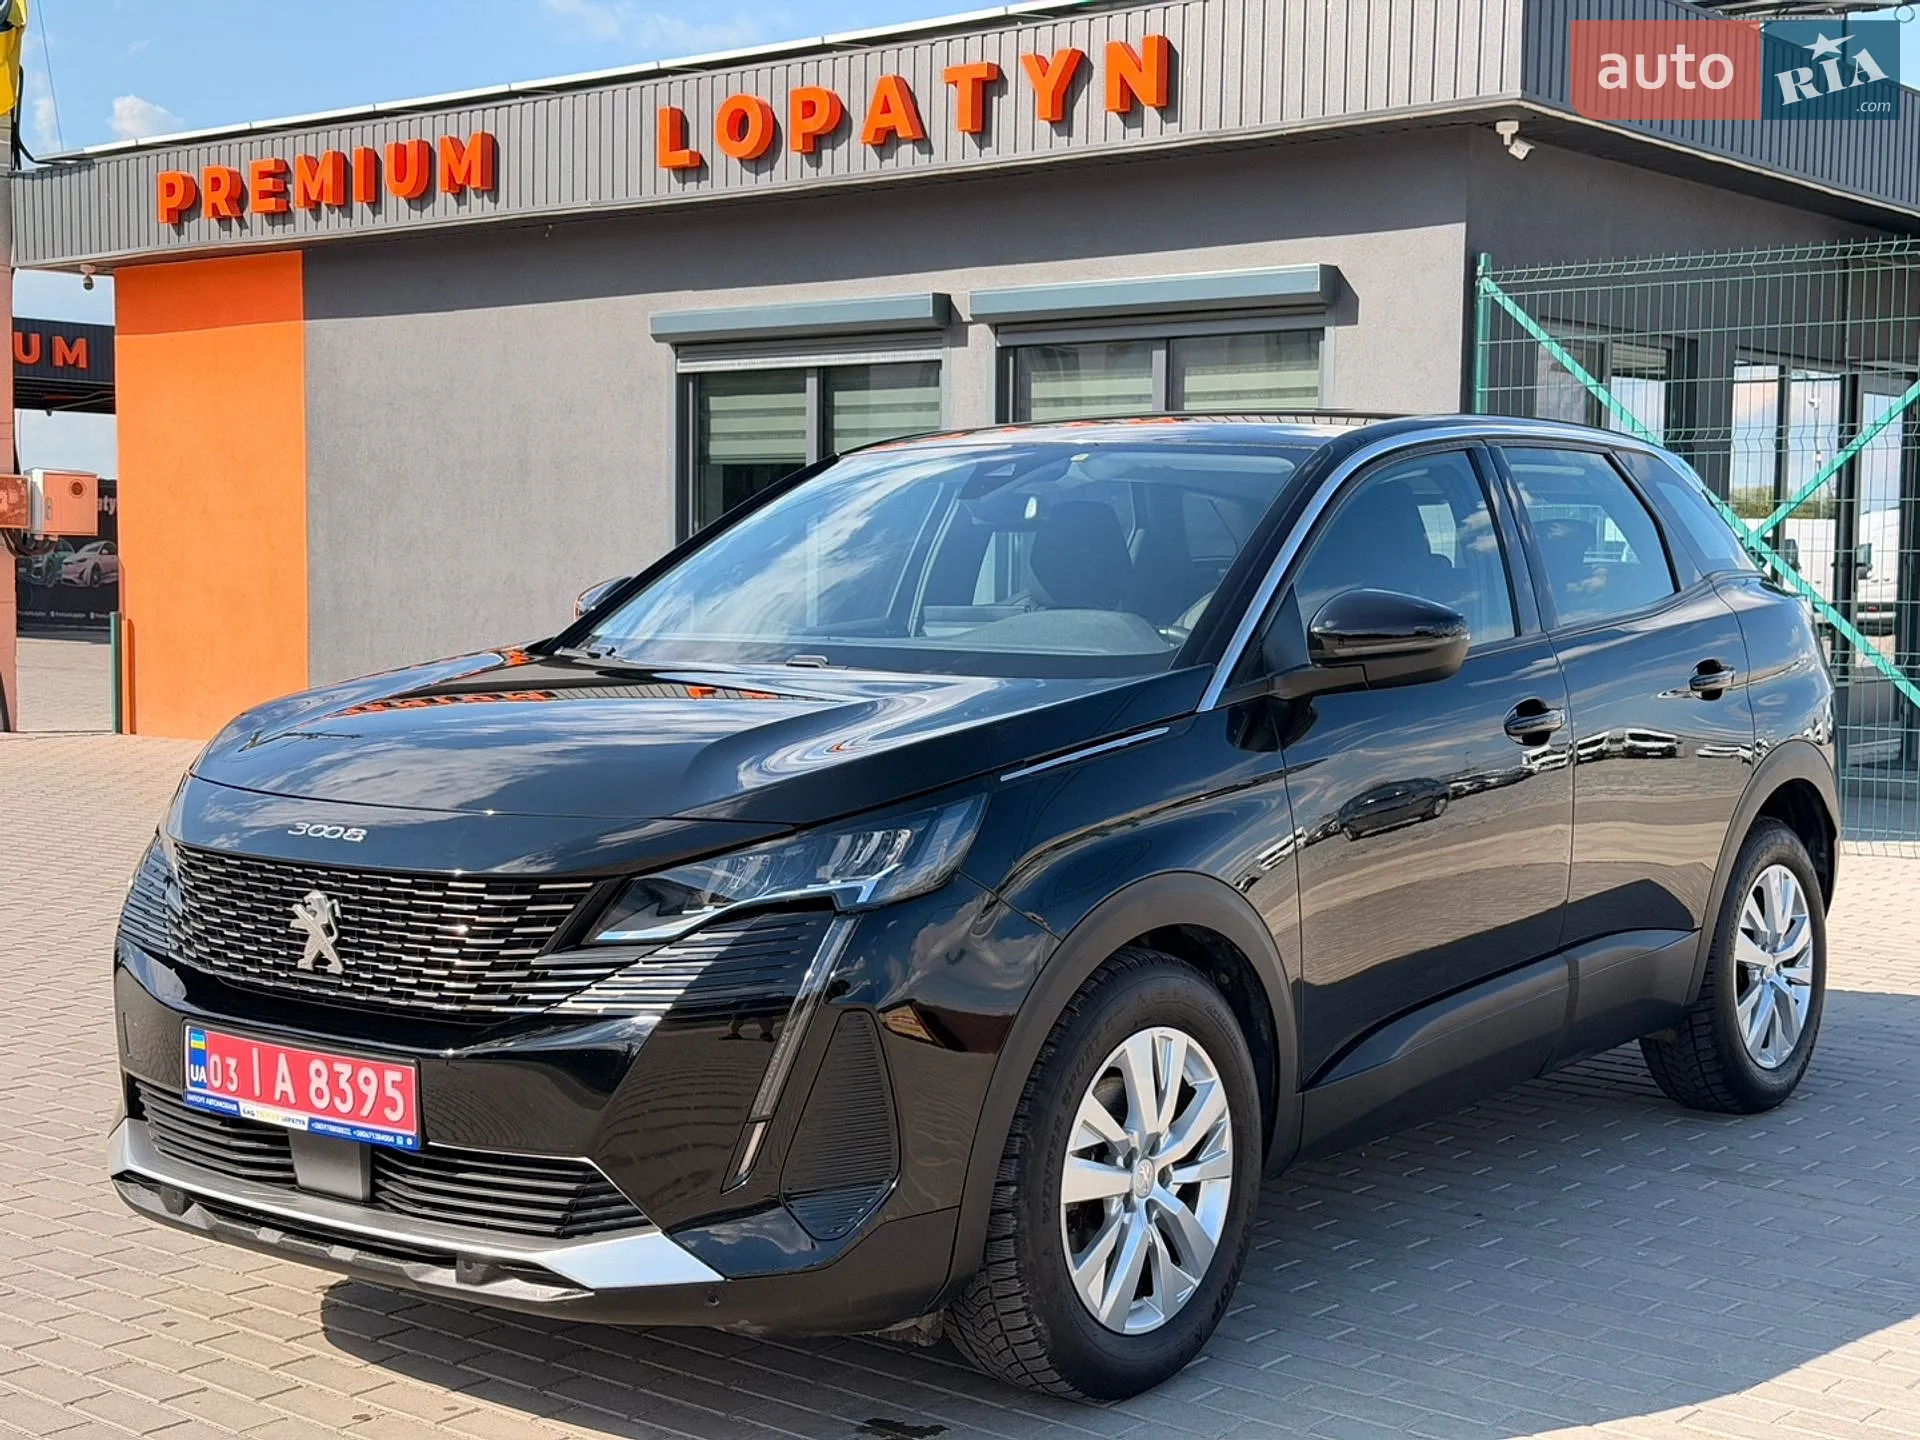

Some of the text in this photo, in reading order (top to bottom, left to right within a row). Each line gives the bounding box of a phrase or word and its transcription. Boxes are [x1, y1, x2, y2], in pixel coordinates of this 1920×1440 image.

[157, 34, 1169, 224] PREMIUM LOPATYN
[287, 822, 368, 843] 3008
[190, 1064, 207, 1083] UA
[209, 1047, 405, 1122] 03 IA 8395
